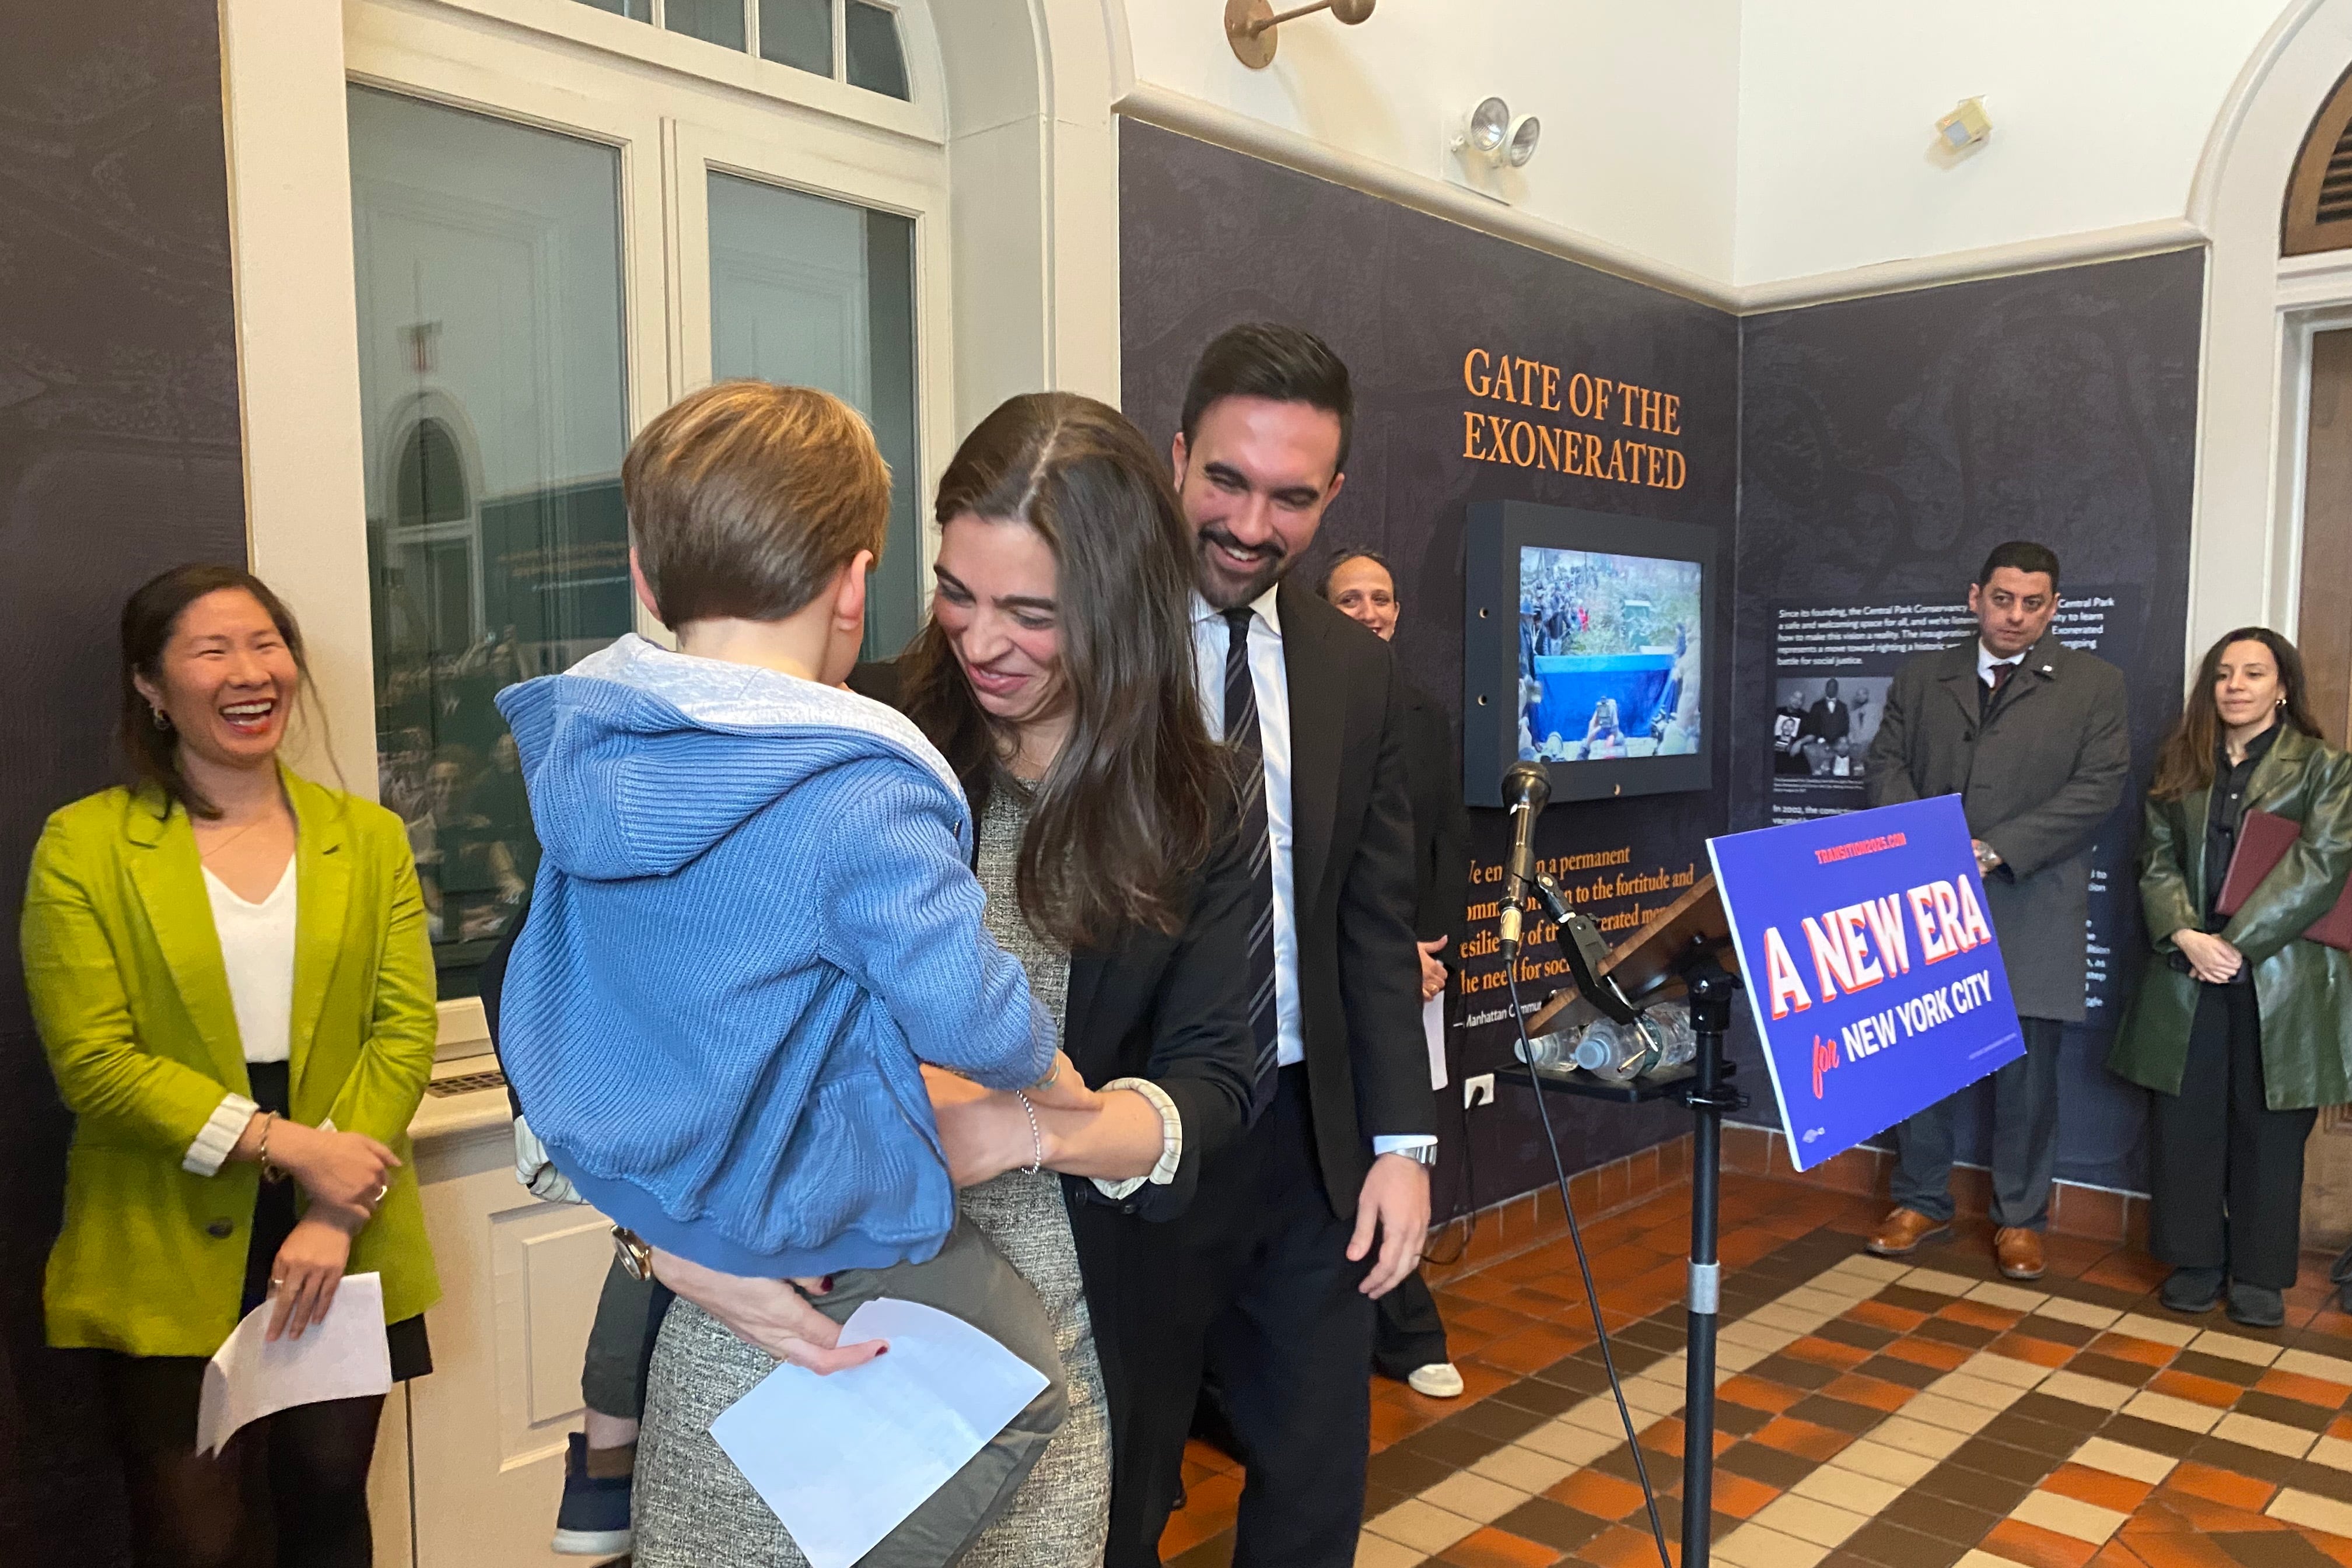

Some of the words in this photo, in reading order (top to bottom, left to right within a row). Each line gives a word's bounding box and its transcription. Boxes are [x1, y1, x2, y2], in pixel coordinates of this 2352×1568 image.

[1464, 348, 1560, 411] GATE
[1569, 373, 1612, 420] OF
[1618, 381, 1681, 435] THE
[1463, 411, 1686, 490] EXONERATED
[1801, 621, 1817, 629] and
[1884, 618, 1896, 627] for
[1910, 617, 1927, 626] and
[2080, 611, 2104, 621] learn
[1863, 606, 1893, 615] Central
[1894, 605, 1913, 614] Park
[1914, 604, 1968, 614] Conservancy
[2058, 598, 2092, 608] Central
[2093, 597, 2115, 607] Park
[1902, 629, 1918, 638] The
[2052, 624, 2104, 635] Exonerated
[1773, 804, 1781, 813] In
[1549, 858, 1558, 874] a
[1559, 846, 1631, 880] permanent
[1815, 832, 1906, 864] TRANSITION2025.COM
[1576, 884, 1590, 904] to
[1592, 876, 1614, 901] the
[1615, 867, 1670, 897] fortitude
[1672, 862, 1694, 888] and
[1527, 919, 1544, 946] of
[1764, 928, 1812, 1020] A
[1802, 893, 1909, 1003] NEW
[1907, 874, 1991, 965] ERA
[1461, 968, 1479, 995] he
[1521, 956, 1542, 982] for
[1812, 1035, 1839, 1098] for
[1842, 1009, 1896, 1062] NEW
[1895, 987, 1954, 1037] YORK
[1951, 970, 1992, 1014] CITY
